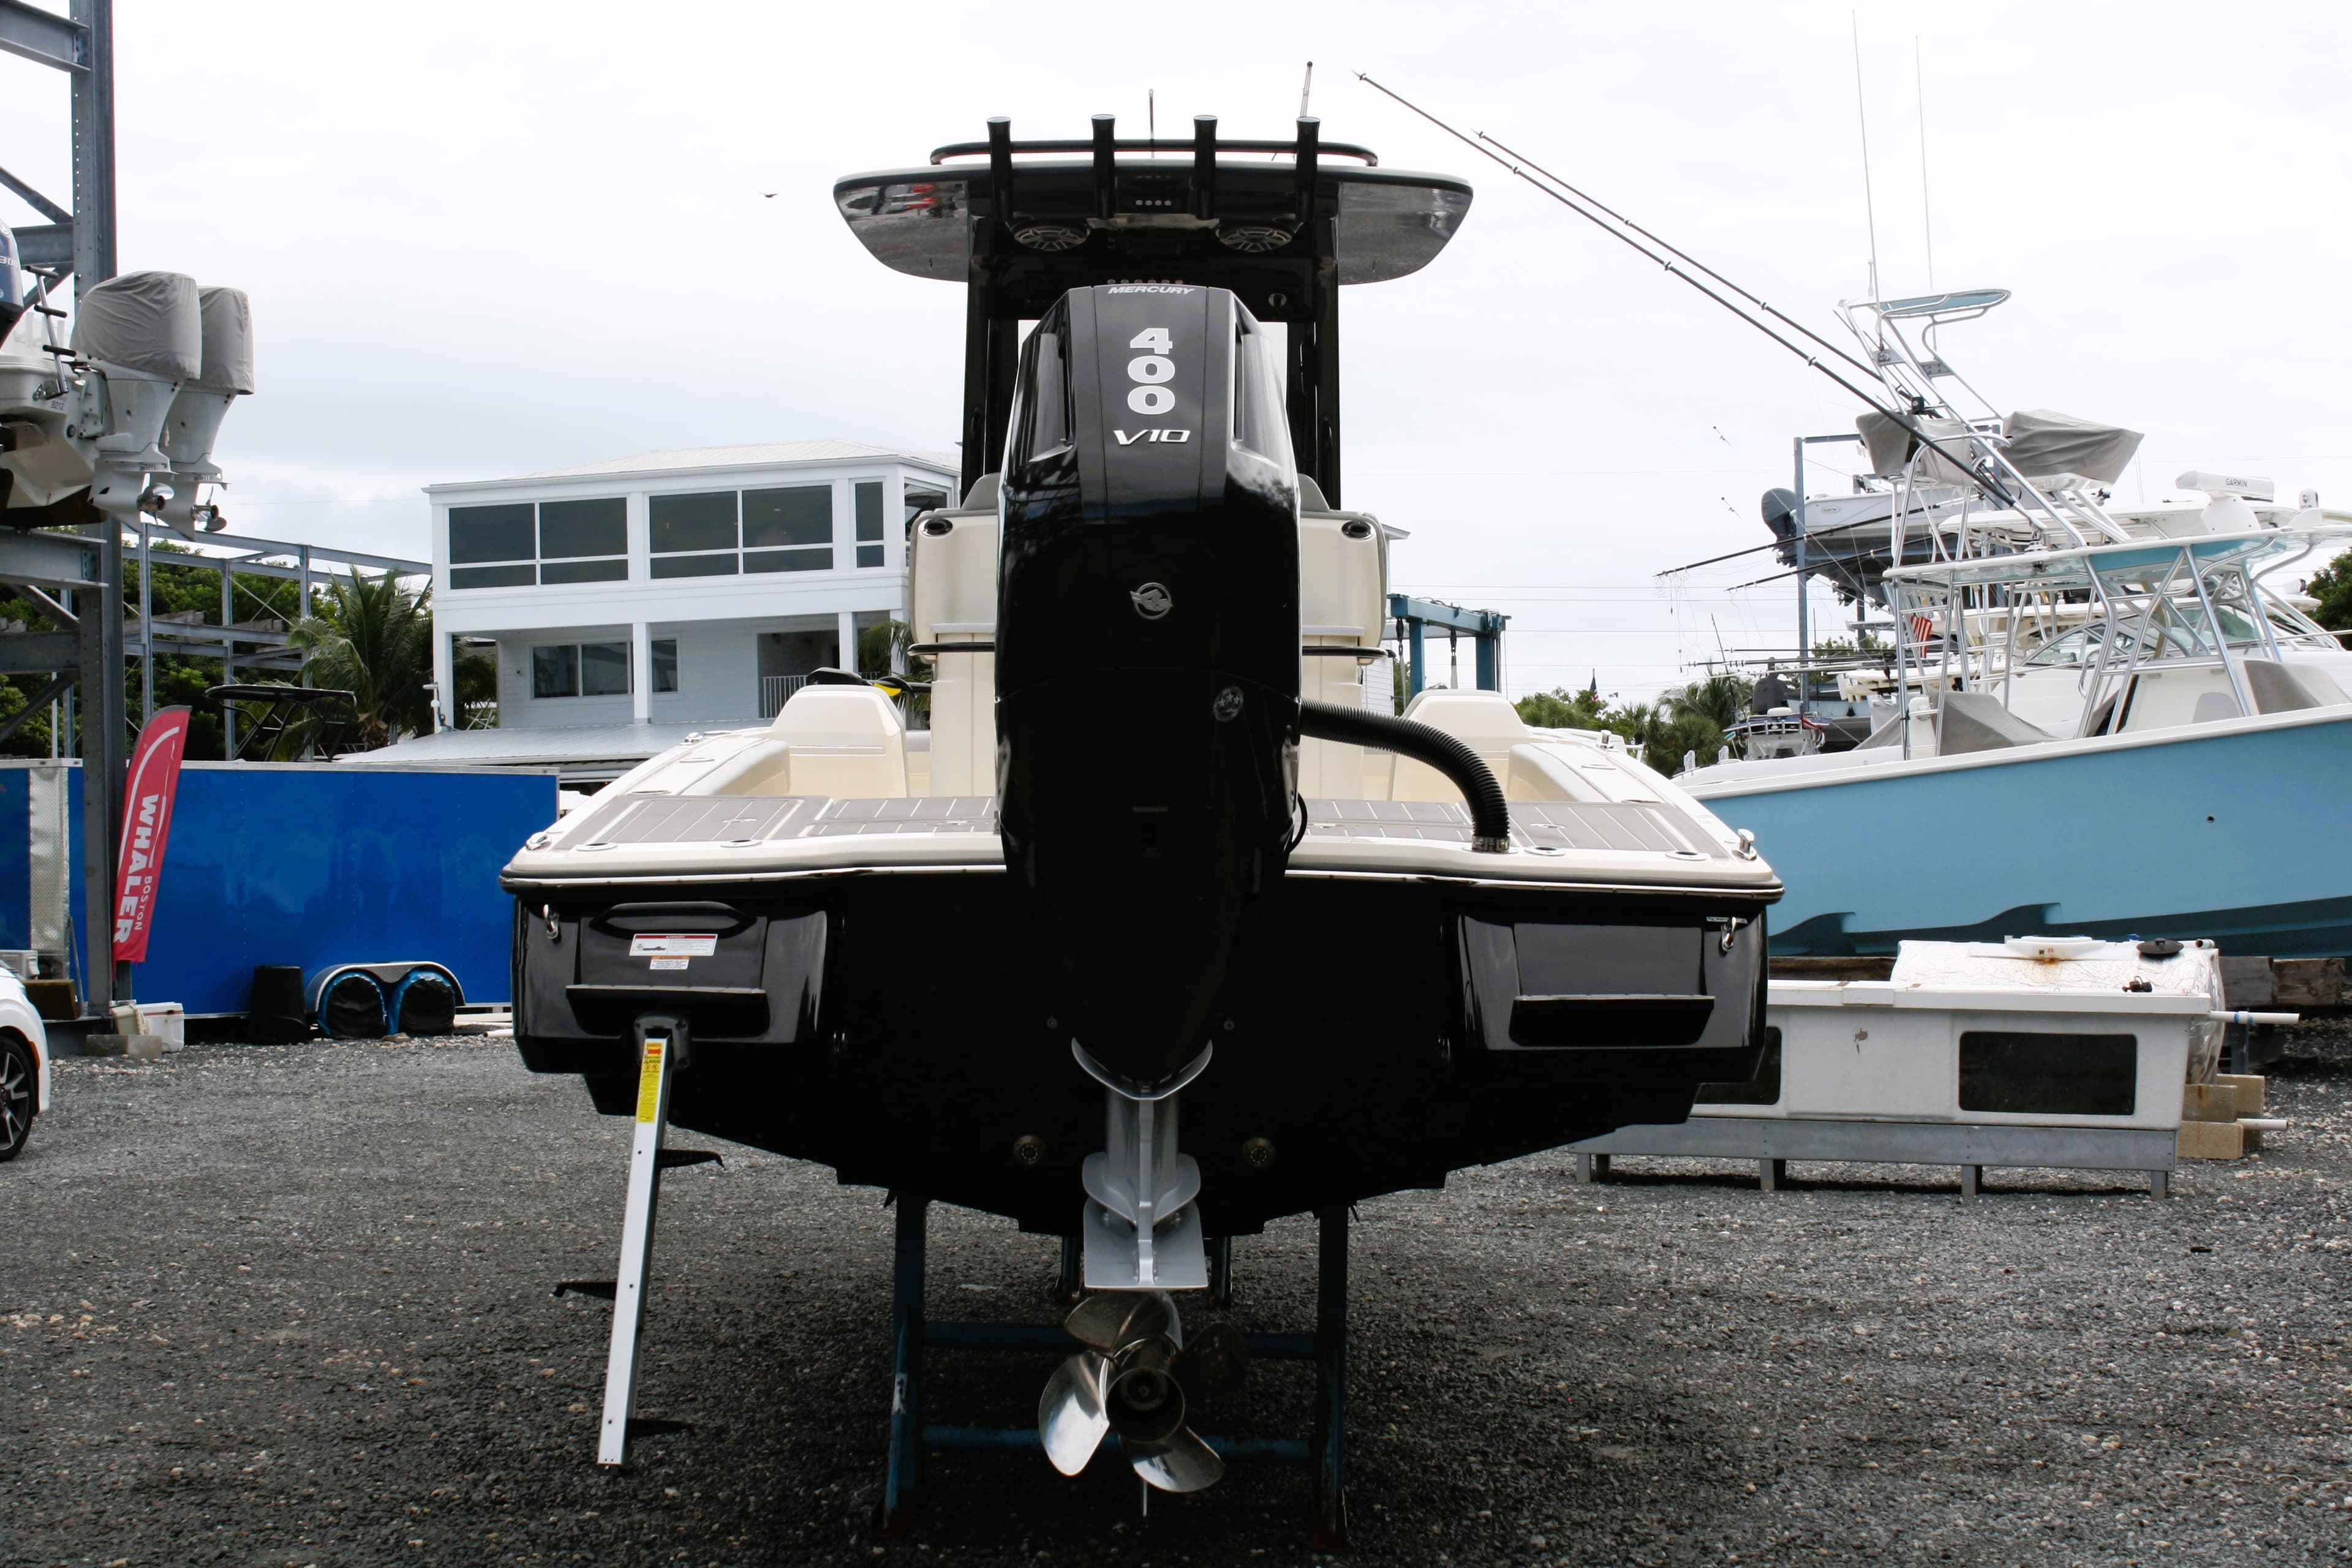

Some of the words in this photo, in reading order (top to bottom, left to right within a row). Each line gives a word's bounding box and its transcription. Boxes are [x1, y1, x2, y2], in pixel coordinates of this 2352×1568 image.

[1107, 286, 1196, 295] MERCURY
[1127, 328, 1175, 415] 400
[1114, 429, 1191, 445] V10
[2225, 478, 2248, 488] GARMIN
[113, 794, 159, 943] WHALER
[134, 876, 153, 930] BOSTON
